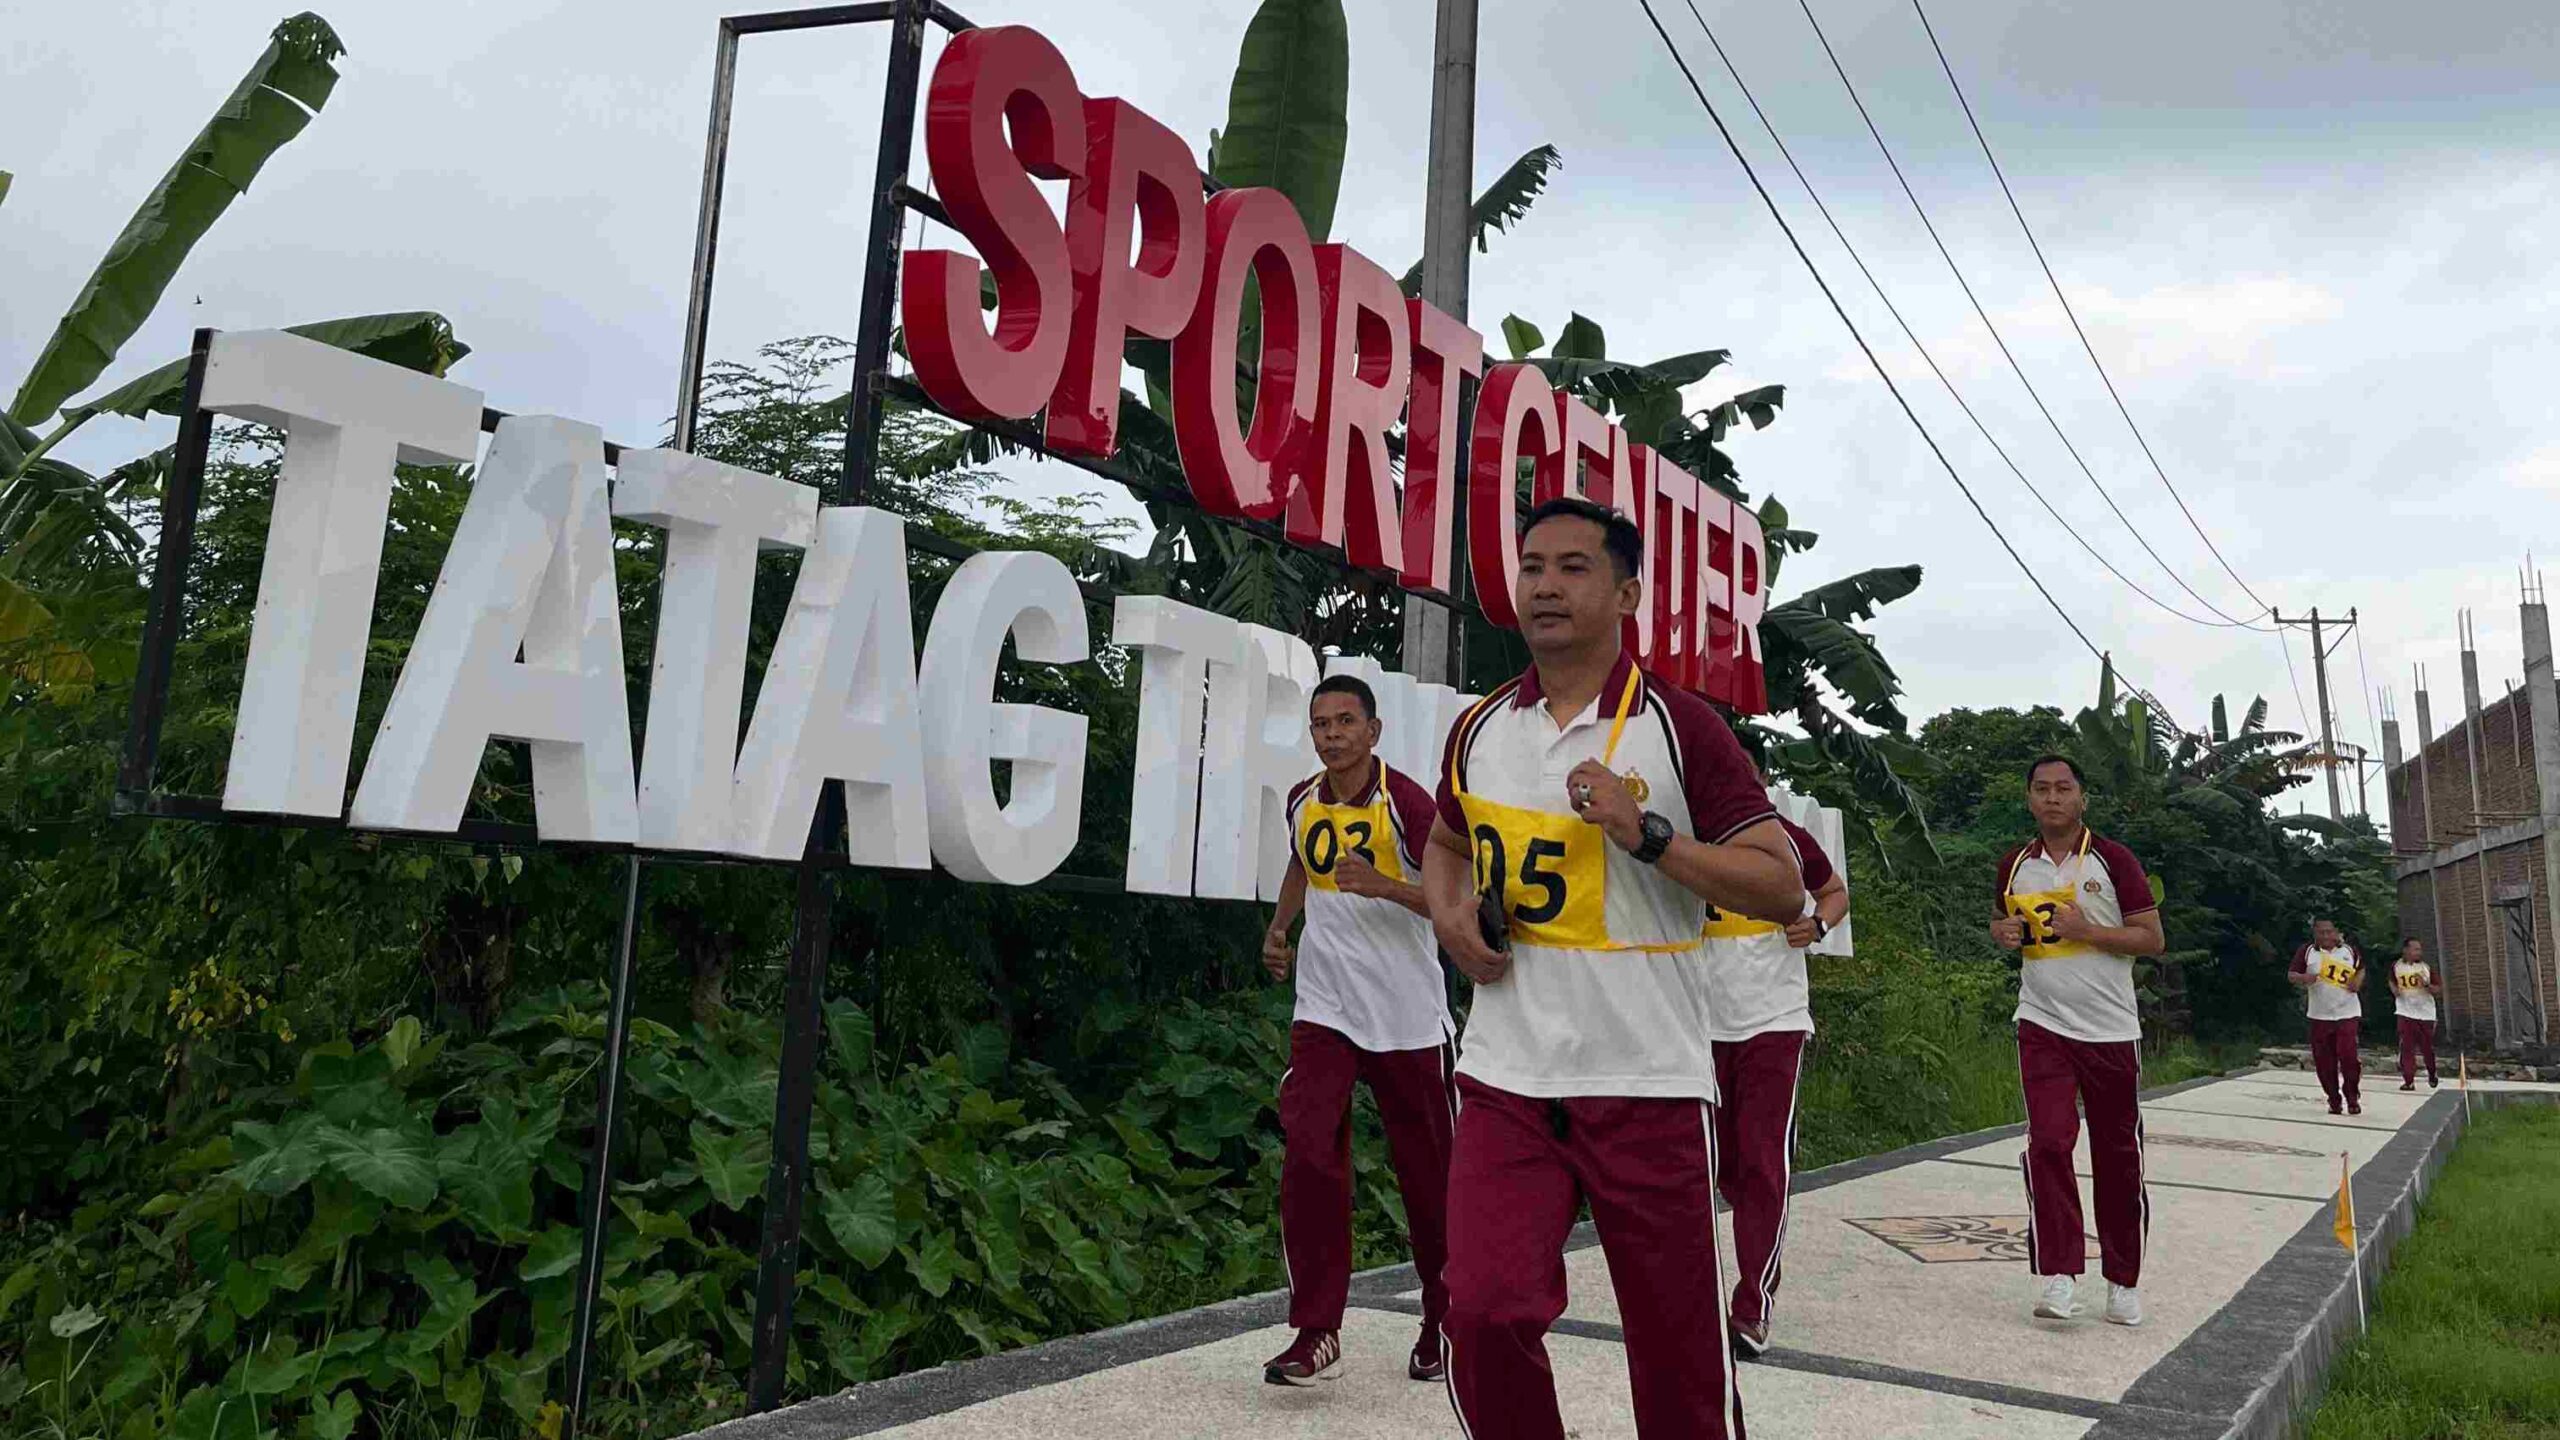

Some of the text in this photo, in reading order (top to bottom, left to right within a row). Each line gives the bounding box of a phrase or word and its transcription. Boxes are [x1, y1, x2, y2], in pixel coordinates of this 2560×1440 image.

[902, 25, 1483, 593] SPORT
[202, 329, 1090, 886] TATAG
[1305, 818, 1375, 874] 03
[1474, 823, 1567, 924] 05
[2326, 964, 2350, 985] 15
